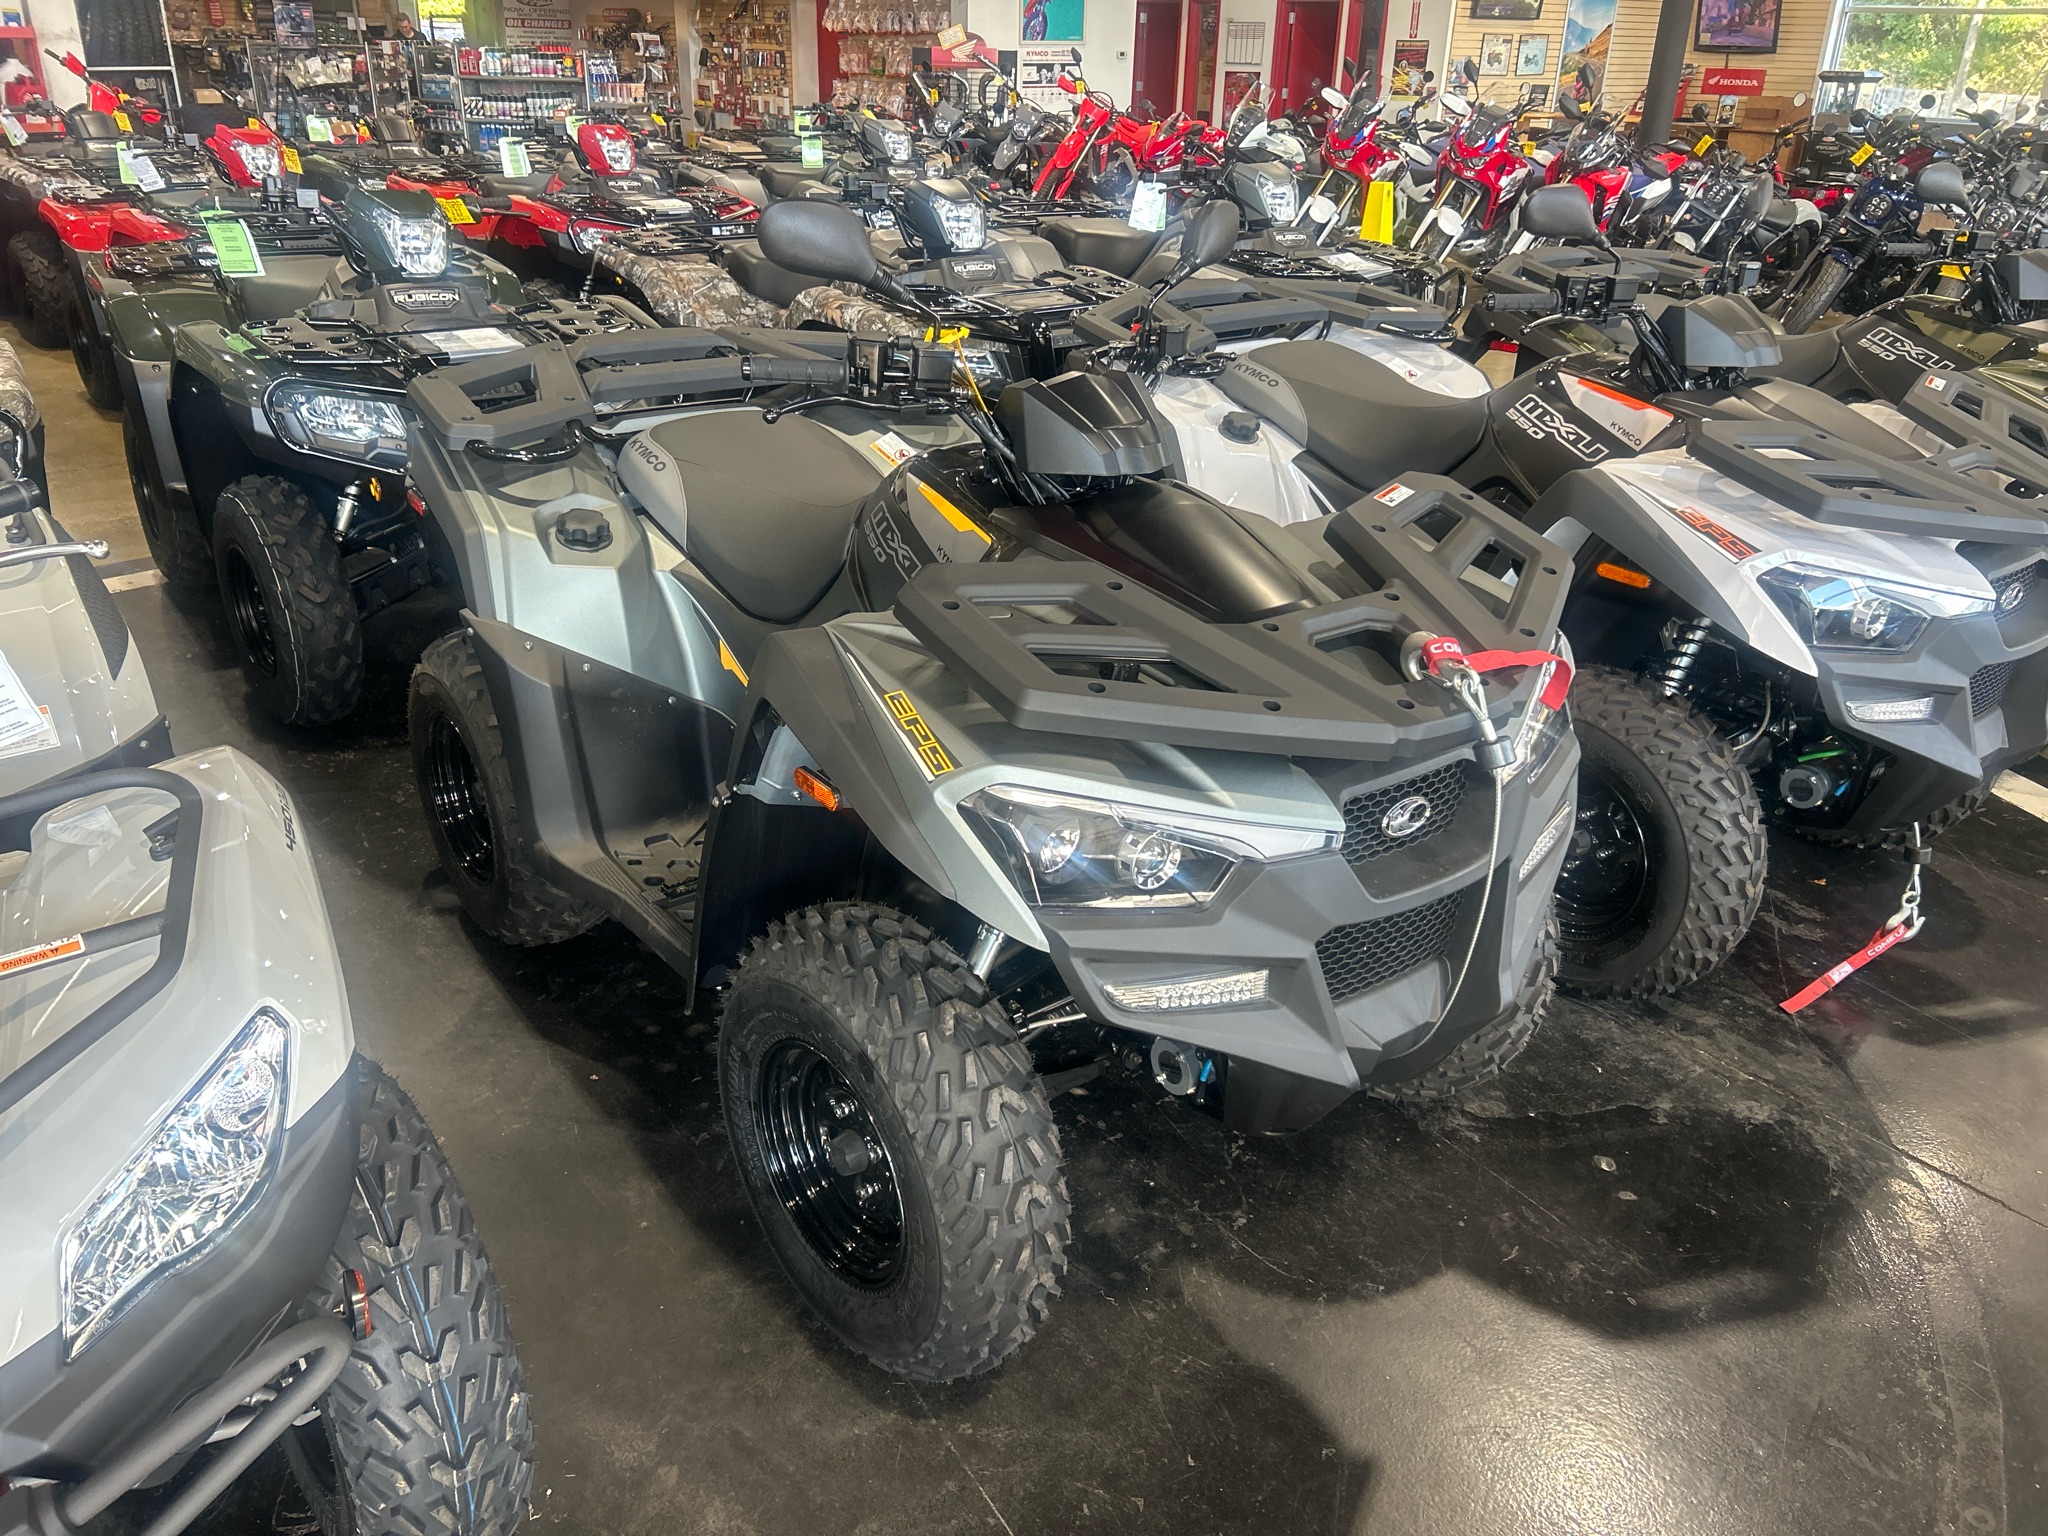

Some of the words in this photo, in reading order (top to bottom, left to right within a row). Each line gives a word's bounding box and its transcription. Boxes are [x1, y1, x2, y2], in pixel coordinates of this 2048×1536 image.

[507, 19, 522, 27] OIL
[524, 19, 570, 29] CHANGES
[1719, 78, 1759, 87] HONDA
[953, 263, 997, 273] RUBICON
[393, 292, 460, 304] RUBICON
[1857, 338, 1898, 361] 550
[1233, 362, 1279, 387] KYMCO
[1505, 407, 1546, 440] 550
[1515, 393, 1610, 462] MXU
[1610, 420, 1642, 447] KYMCO
[629, 437, 667, 472] KYMCO
[863, 518, 887, 563] 550
[1675, 505, 1756, 559] EPS
[883, 689, 955, 776] EPS
[1, 951, 49, 970] WARNING
